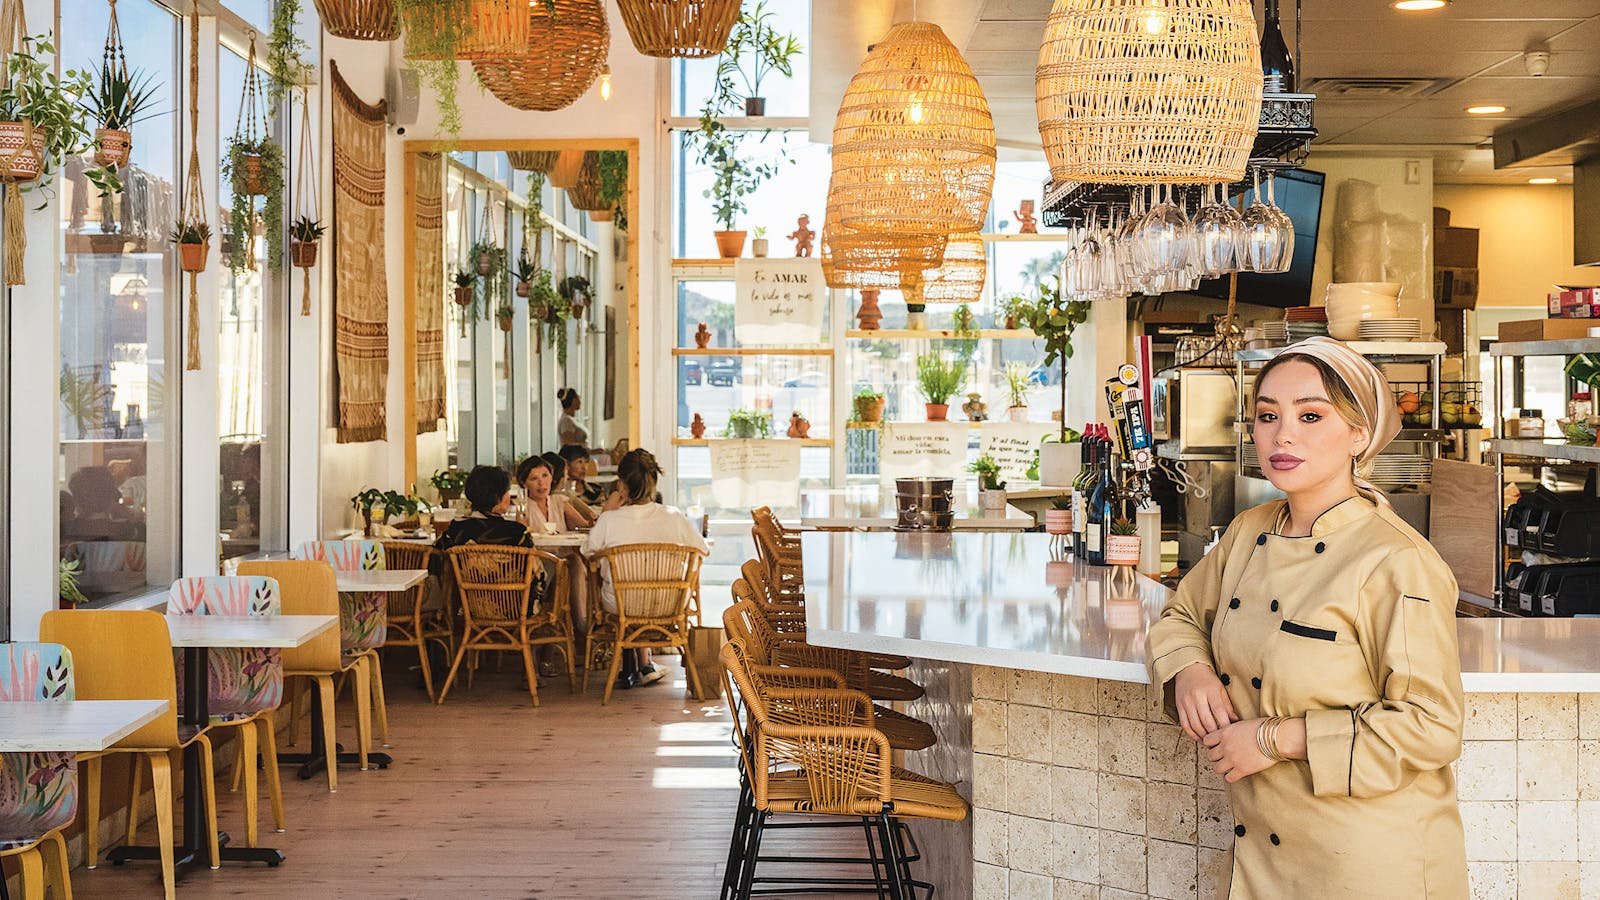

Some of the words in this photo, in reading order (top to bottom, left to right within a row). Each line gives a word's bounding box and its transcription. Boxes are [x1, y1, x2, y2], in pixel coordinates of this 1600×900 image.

[772, 274, 807, 283] AMAR
[762, 288, 779, 300] vida
[1130, 406, 1140, 426] IPA
